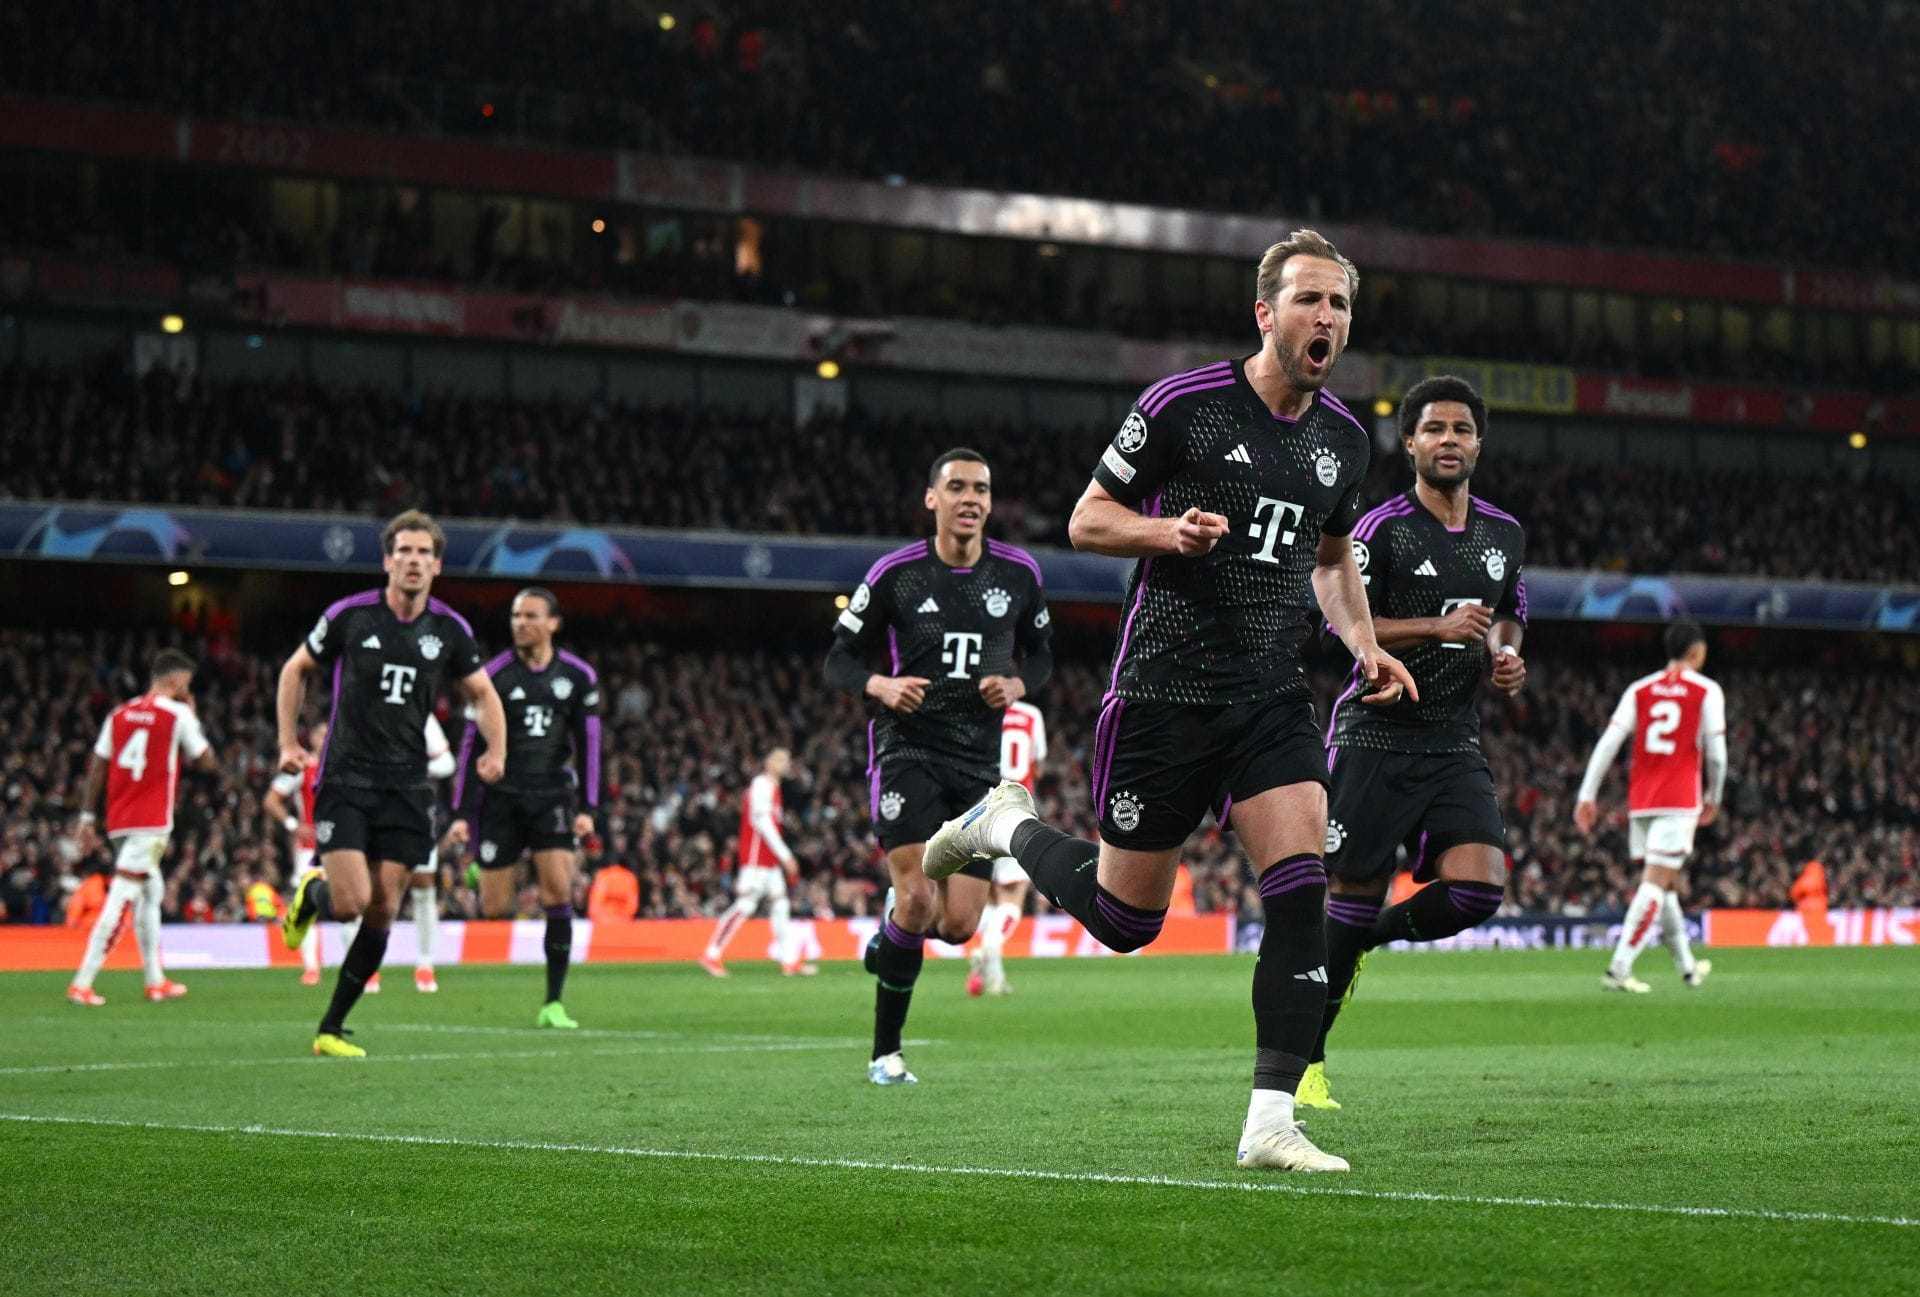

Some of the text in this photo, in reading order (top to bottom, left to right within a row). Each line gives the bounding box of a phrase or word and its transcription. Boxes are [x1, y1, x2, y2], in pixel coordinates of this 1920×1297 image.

[1248, 496, 1304, 564] T
[942, 632, 982, 680] T
[380, 663, 417, 705] T
[524, 705, 552, 737] T
[1645, 699, 1682, 755] 2
[117, 728, 149, 782] 4
